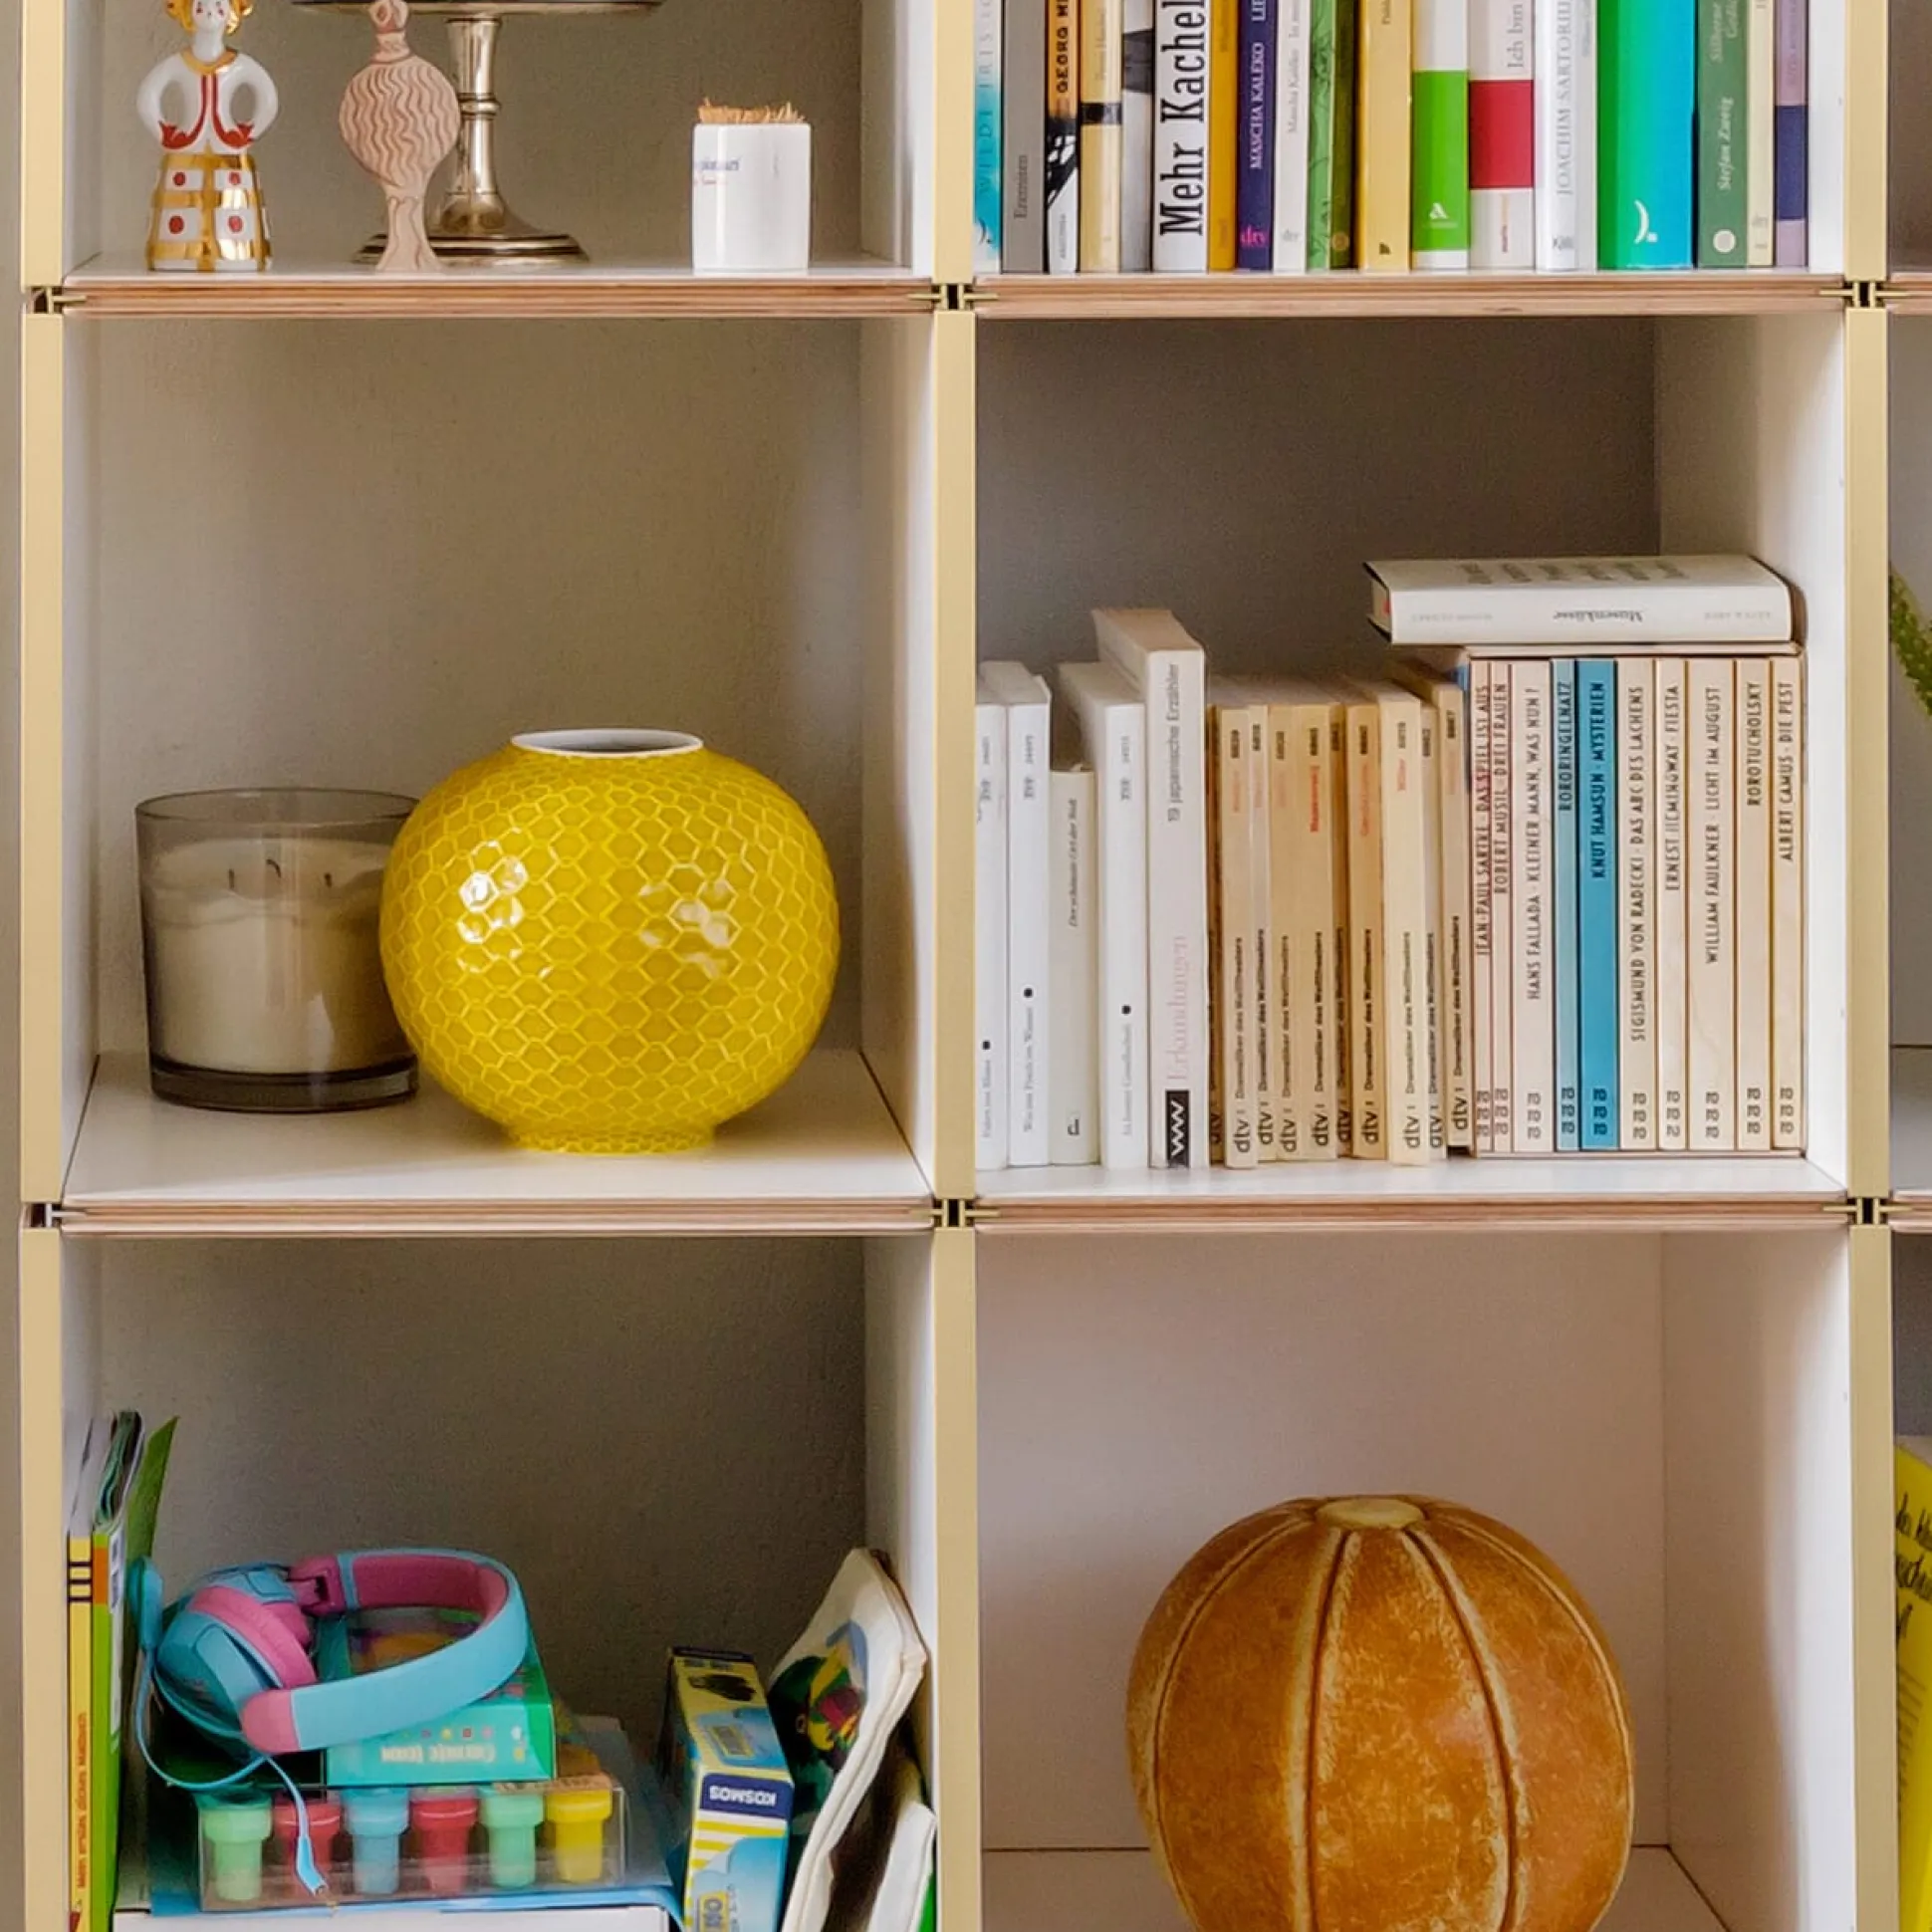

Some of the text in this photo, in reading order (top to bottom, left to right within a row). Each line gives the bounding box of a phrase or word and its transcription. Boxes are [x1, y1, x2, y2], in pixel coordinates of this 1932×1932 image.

[1056, 27, 1069, 95] GEORG
[1508, 3, 1524, 68] Ich bin
[1159, 0, 1206, 236] Mehr Kachel
[1557, 0, 1572, 195] JOACHIM SARTORIU
[1250, 105, 1265, 169] MASCHA
[1718, 97, 1735, 191] Stefan Zweig
[1165, 663, 1180, 721] Erzähler
[1666, 685, 1680, 733] FIESTA
[1526, 734, 1540, 763] WAS
[1780, 682, 1794, 862] ALBERT CAMUS DIE PEST
[1494, 683, 1508, 894] ROBERT MUSIL DREI FRAUEN
[1590, 682, 1605, 878] KNUT HAMSUN MYSTERIEN
[1526, 821, 1540, 881] KLEINER
[1705, 687, 1719, 965] WILLIAM FAULKNER LICHT IM AUGUST
[1630, 686, 1645, 1044] SIGISMUND VON RADECKI DAS ABC DES LACHENS
[1666, 838, 1680, 892] ERNEST
[1527, 896, 1541, 957] FALLADA
[1452, 990, 1462, 1010] des
[1527, 962, 1541, 1001] HANS
[1165, 935, 1189, 1083] Erkundungen
[1258, 1004, 1267, 1025] des
[1281, 1011, 1290, 1032] des
[1314, 1006, 1324, 1027] des
[1363, 1003, 1373, 1024] des
[1233, 1119, 1251, 1154] dtv
[1257, 1112, 1274, 1146] dtv
[1280, 1119, 1297, 1154] dtv
[1312, 1113, 1328, 1147] dtv
[1361, 1111, 1378, 1146] dtv
[1403, 1115, 1420, 1150] dtv
[1451, 1097, 1468, 1132] dtv
[709, 1785, 778, 1808] KOSMOS
